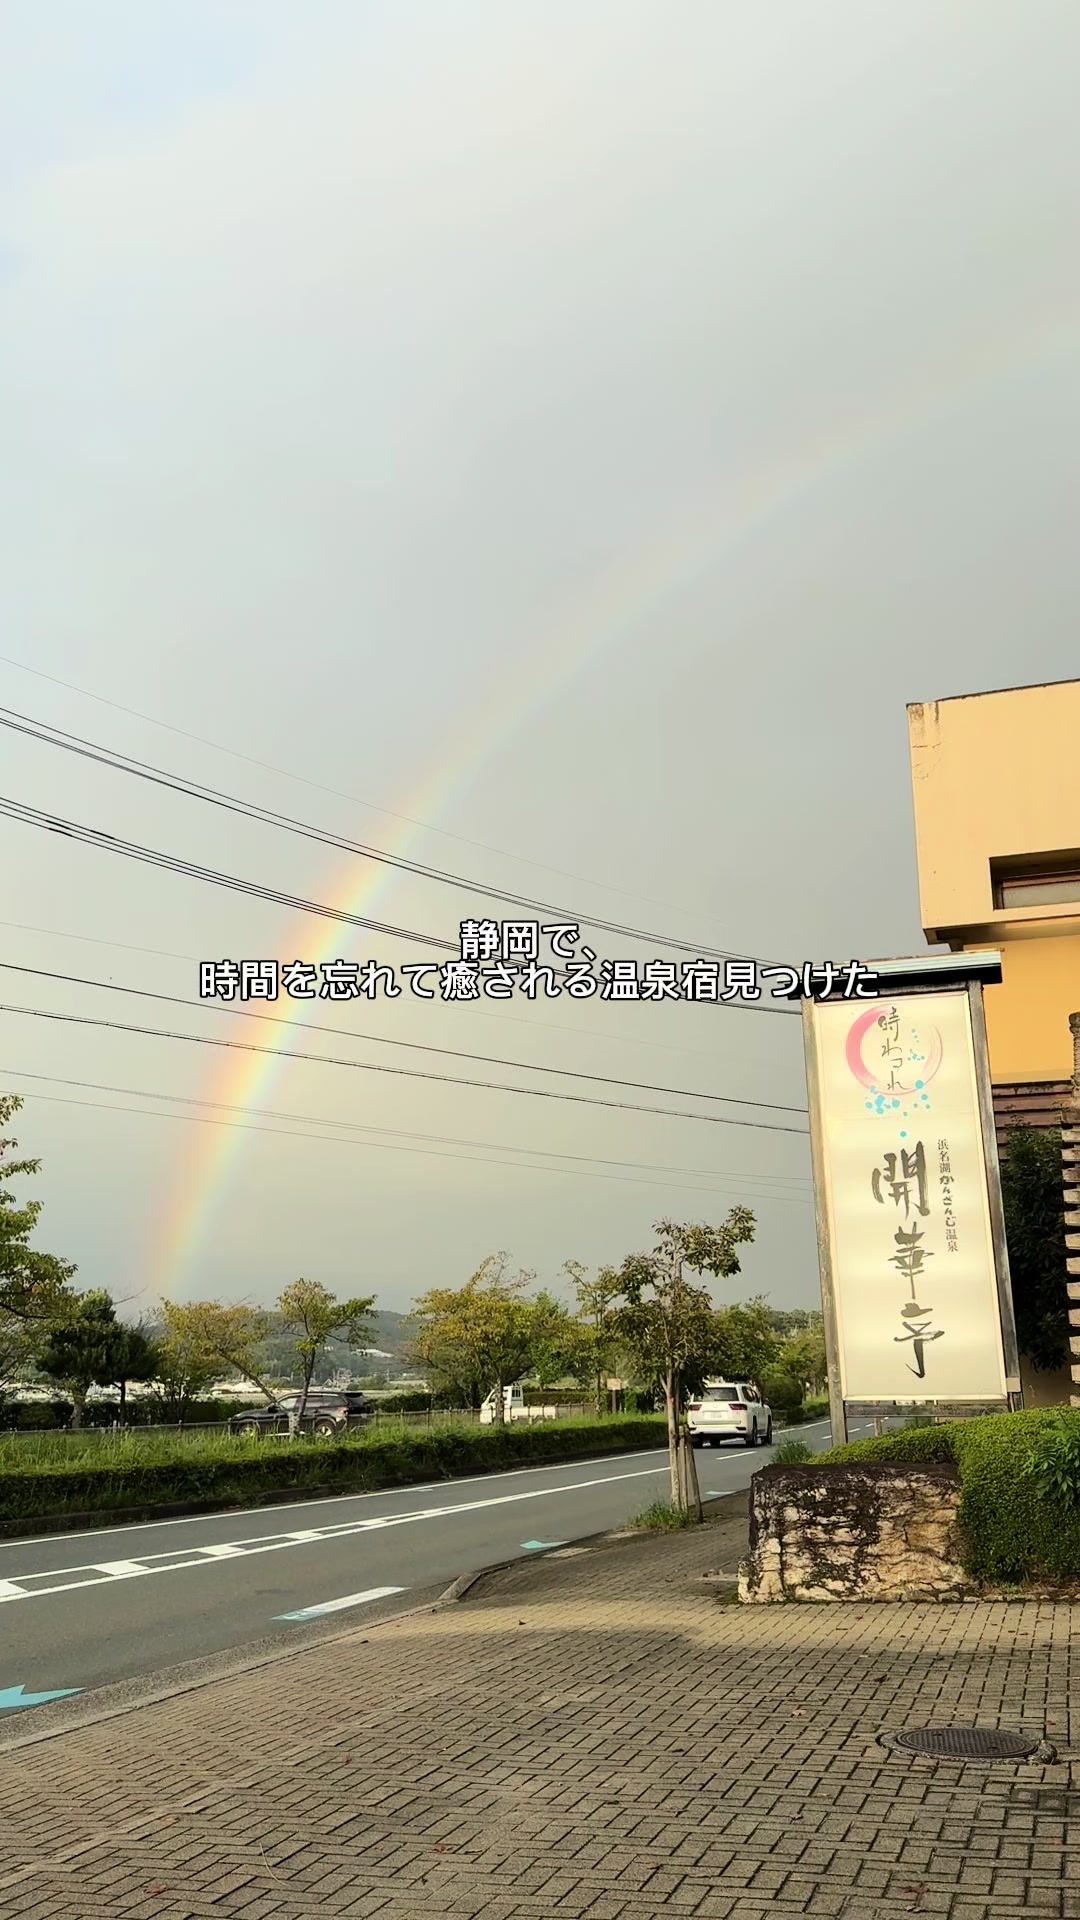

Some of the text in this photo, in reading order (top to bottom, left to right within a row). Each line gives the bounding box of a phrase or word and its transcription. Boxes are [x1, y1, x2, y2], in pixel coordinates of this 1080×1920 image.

[871, 1140, 945, 1379] 開華亭
[937, 1138, 959, 1253] 浜名湖かんざんじ温泉
